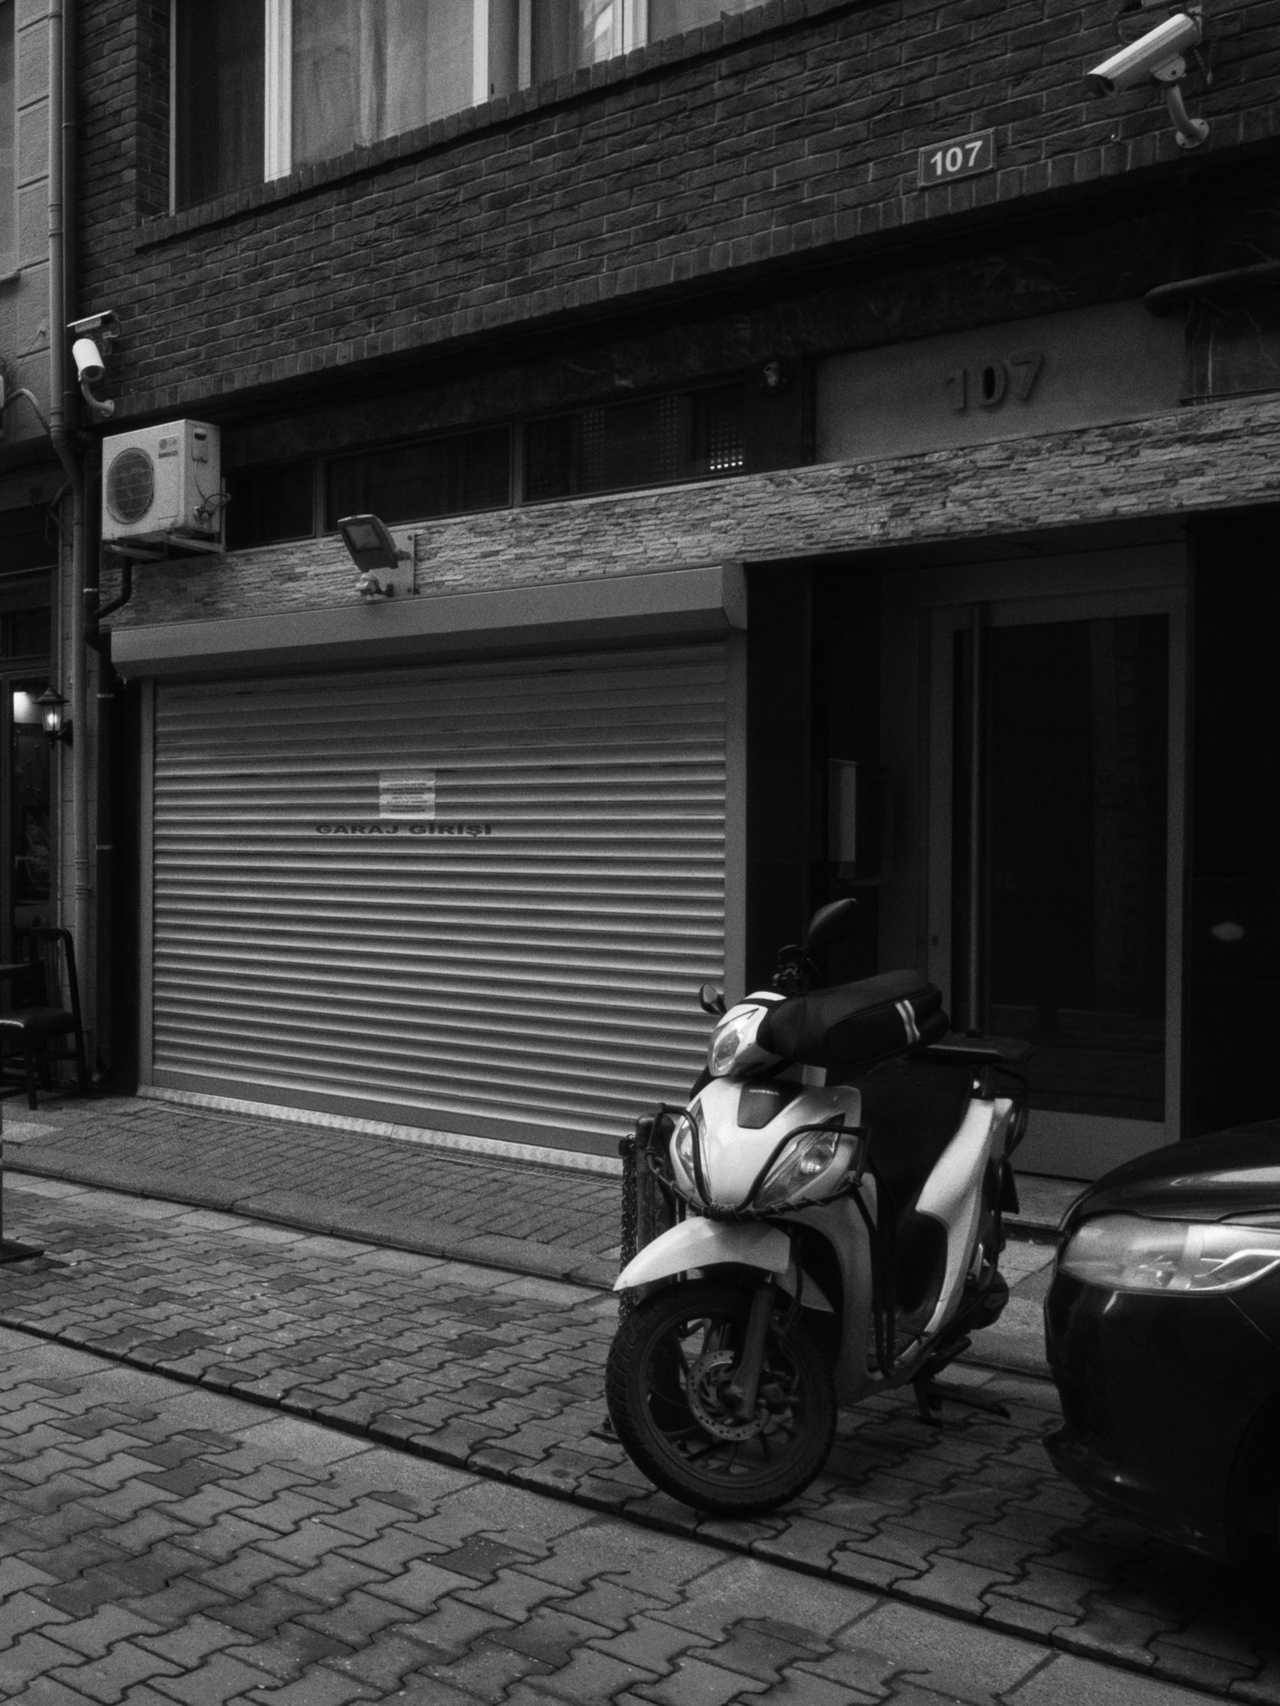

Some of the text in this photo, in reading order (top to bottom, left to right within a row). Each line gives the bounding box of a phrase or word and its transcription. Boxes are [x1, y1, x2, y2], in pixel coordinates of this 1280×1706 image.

[931, 141, 983, 176] 107
[946, 355, 1044, 412] 107
[315, 822, 493, 838] GARAJ GİRİŞİ
